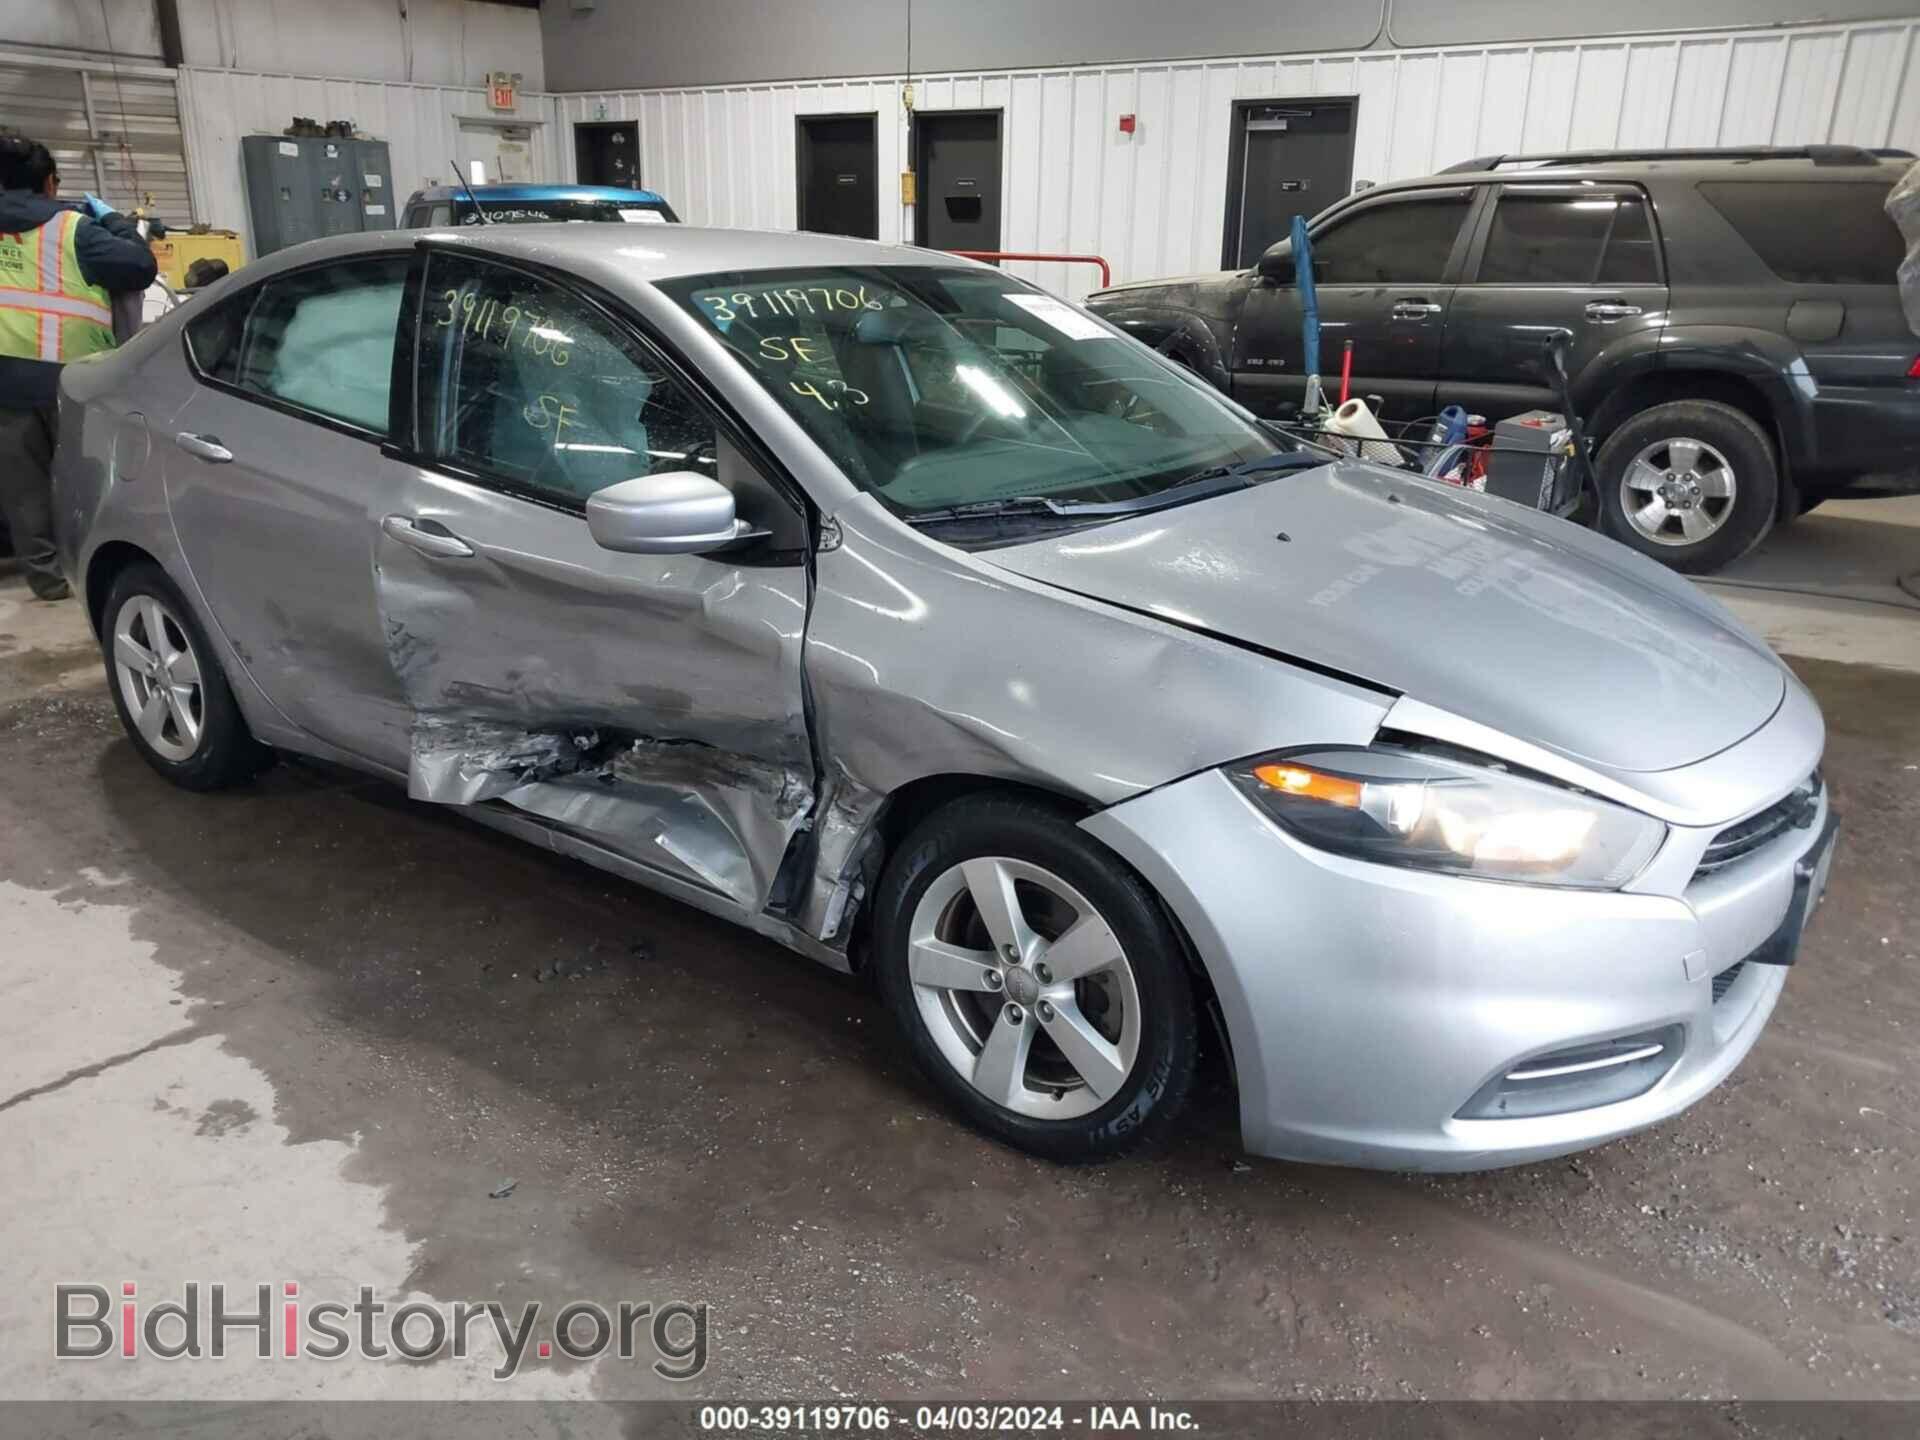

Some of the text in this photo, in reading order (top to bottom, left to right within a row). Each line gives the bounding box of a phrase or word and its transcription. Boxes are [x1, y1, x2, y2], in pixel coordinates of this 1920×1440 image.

[495, 88, 512, 106] EXIT
[704, 286, 884, 320] 39119706
[437, 289, 575, 366] 39119706
